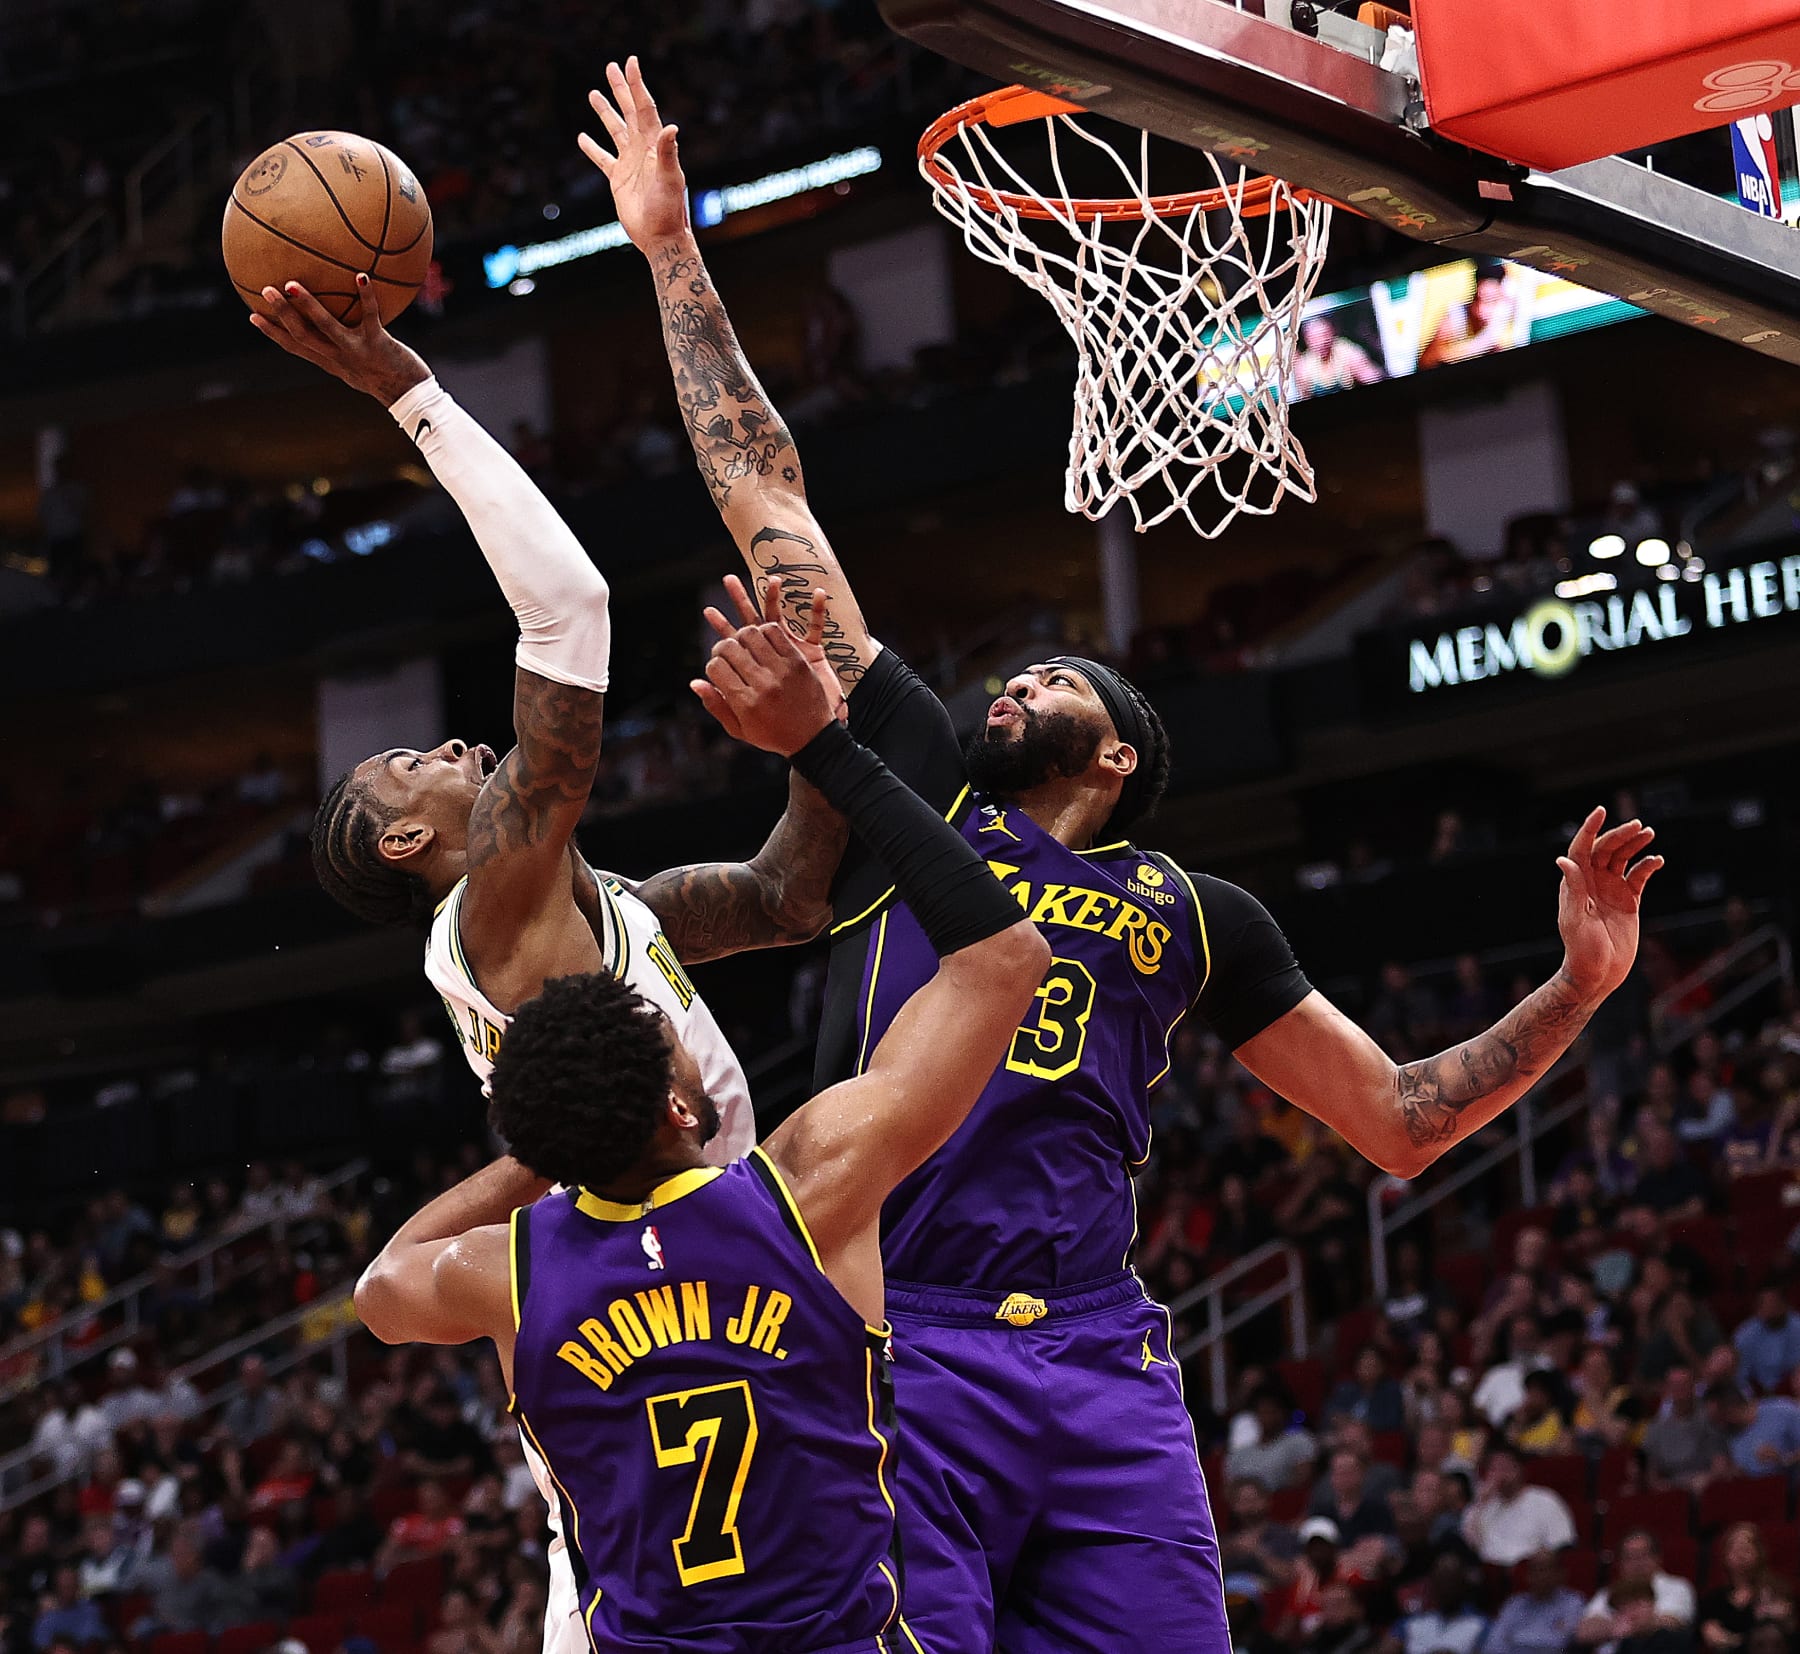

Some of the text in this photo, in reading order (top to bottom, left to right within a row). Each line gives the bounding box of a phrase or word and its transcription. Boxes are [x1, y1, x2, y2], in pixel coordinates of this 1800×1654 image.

[1740, 172, 1769, 217] NBA
[1408, 583, 1693, 693] MEMORIAL
[1126, 878, 1175, 906] bibigo
[1005, 956, 1097, 1082] 3
[556, 1280, 793, 1391] BROWN JR.
[998, 1300, 1045, 1319] LAKERS
[645, 1379, 759, 1588] 7
